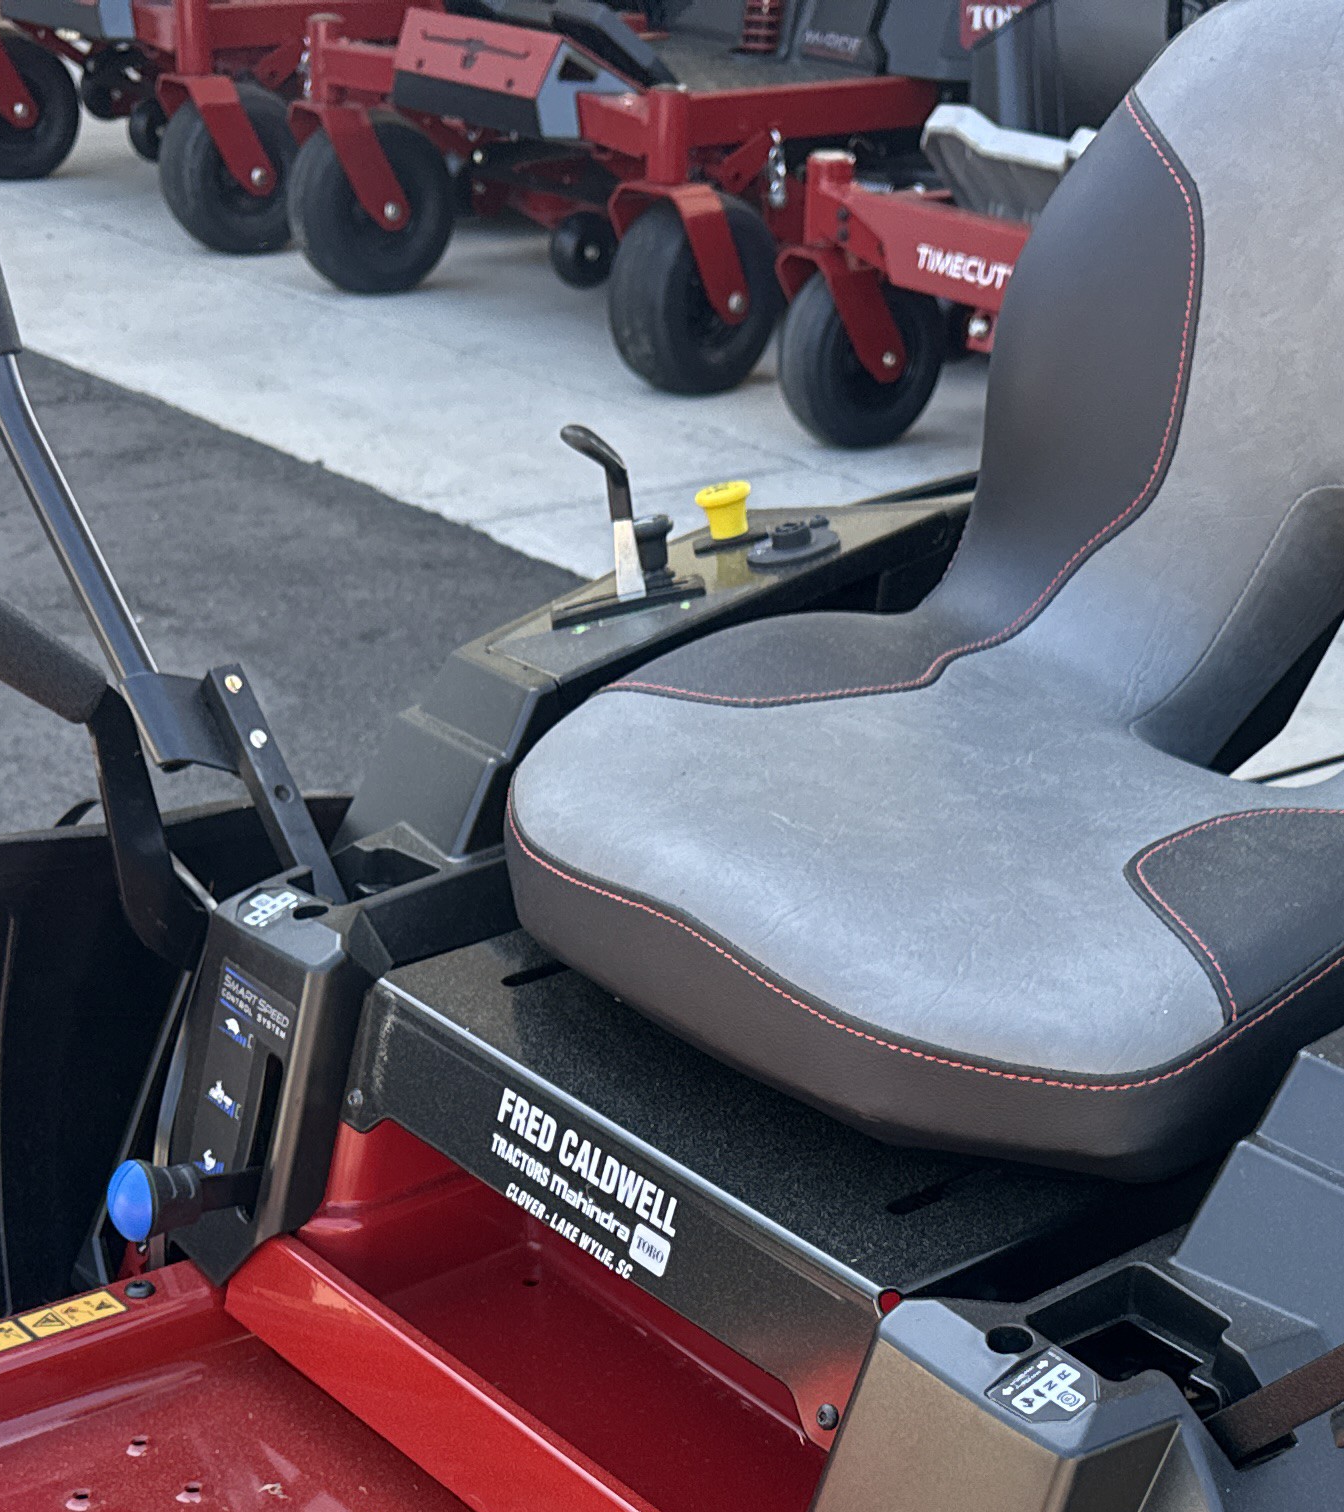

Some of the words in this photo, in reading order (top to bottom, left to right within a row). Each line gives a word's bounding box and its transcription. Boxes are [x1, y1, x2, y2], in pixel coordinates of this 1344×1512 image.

[221, 987, 253, 1018] CONTROL
[223, 974, 258, 1005] SMART
[257, 998, 290, 1029] SPEED
[491, 1133, 551, 1186] TRACTORS
[497, 1088, 557, 1152] FRED
[559, 1129, 677, 1238] CALDWELL
[506, 1183, 546, 1220] CLOVER
[550, 1212, 577, 1244] LAKE
[578, 1234, 614, 1270] WYLIE,
[615, 1259, 634, 1279] SC
[636, 1235, 664, 1264] TORO
